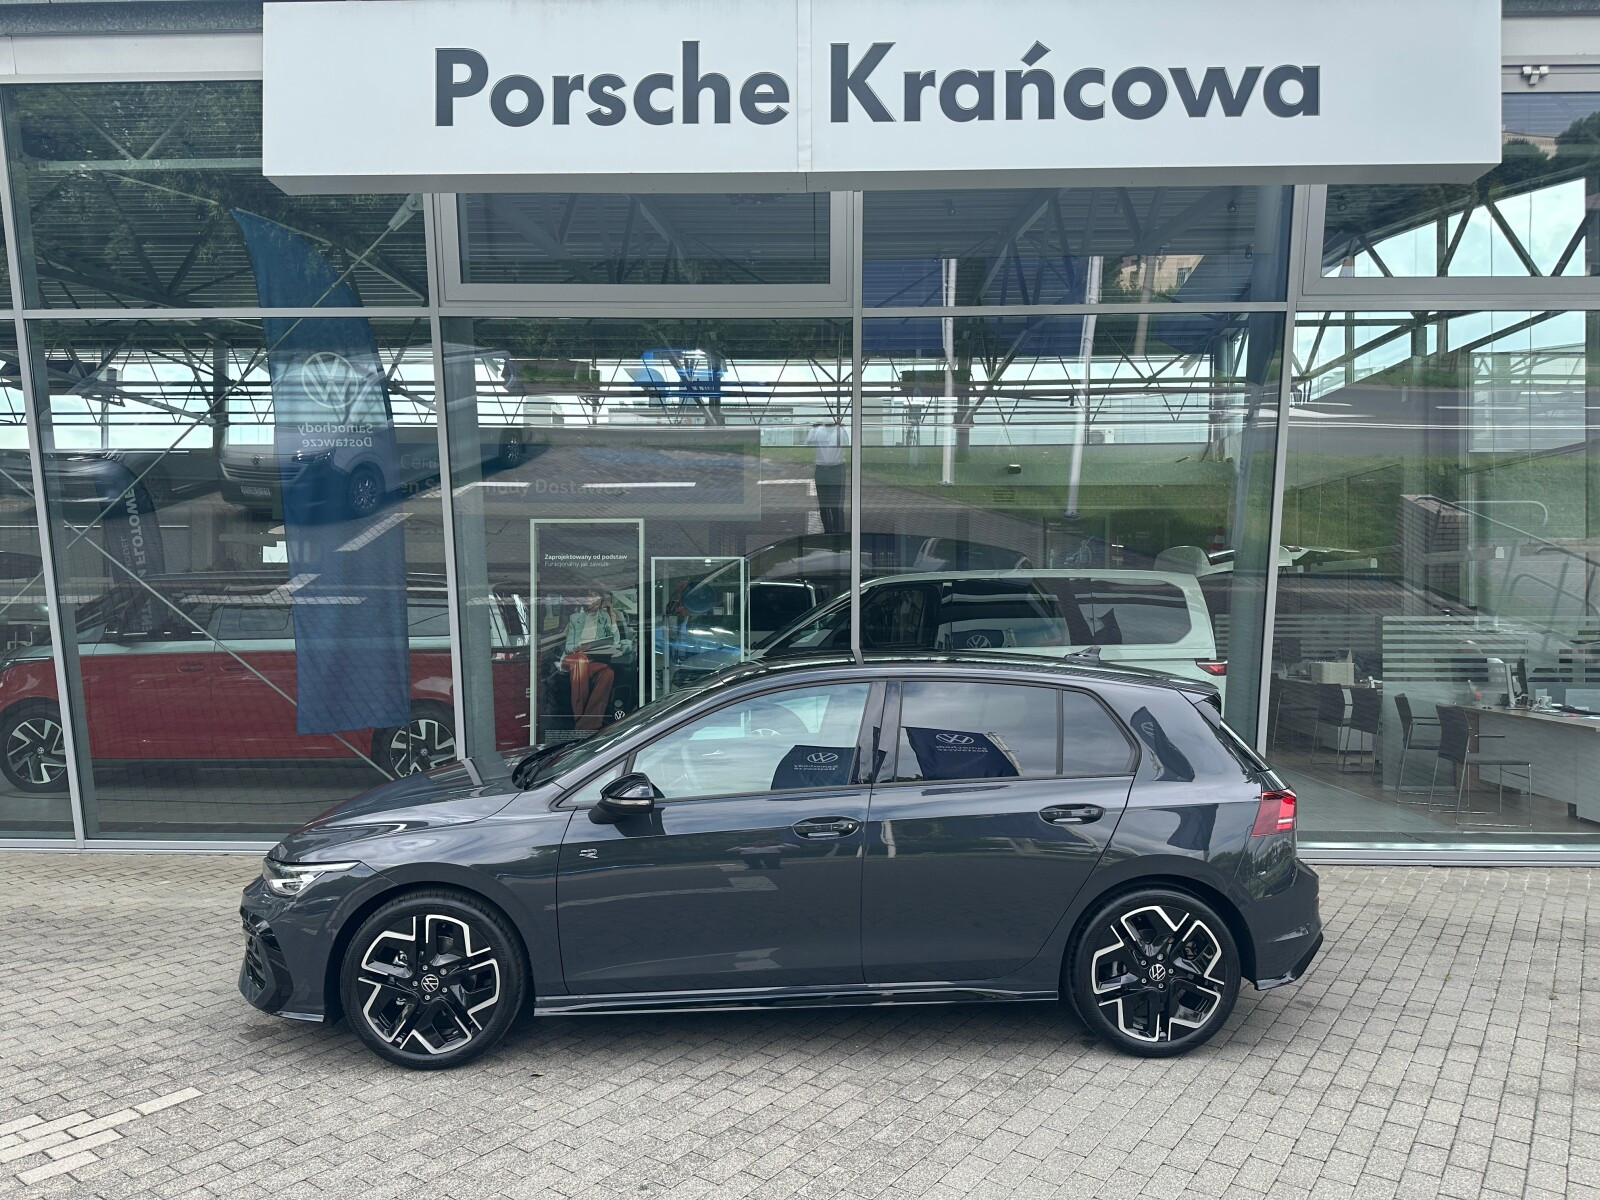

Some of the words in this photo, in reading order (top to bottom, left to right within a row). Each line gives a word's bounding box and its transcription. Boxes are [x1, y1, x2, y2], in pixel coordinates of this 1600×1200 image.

[434, 40, 790, 128] Porsche
[830, 39, 1321, 123] Krańcowa
[544, 553, 592, 561] Zaprojektowany
[601, 553, 628, 561] podstaw
